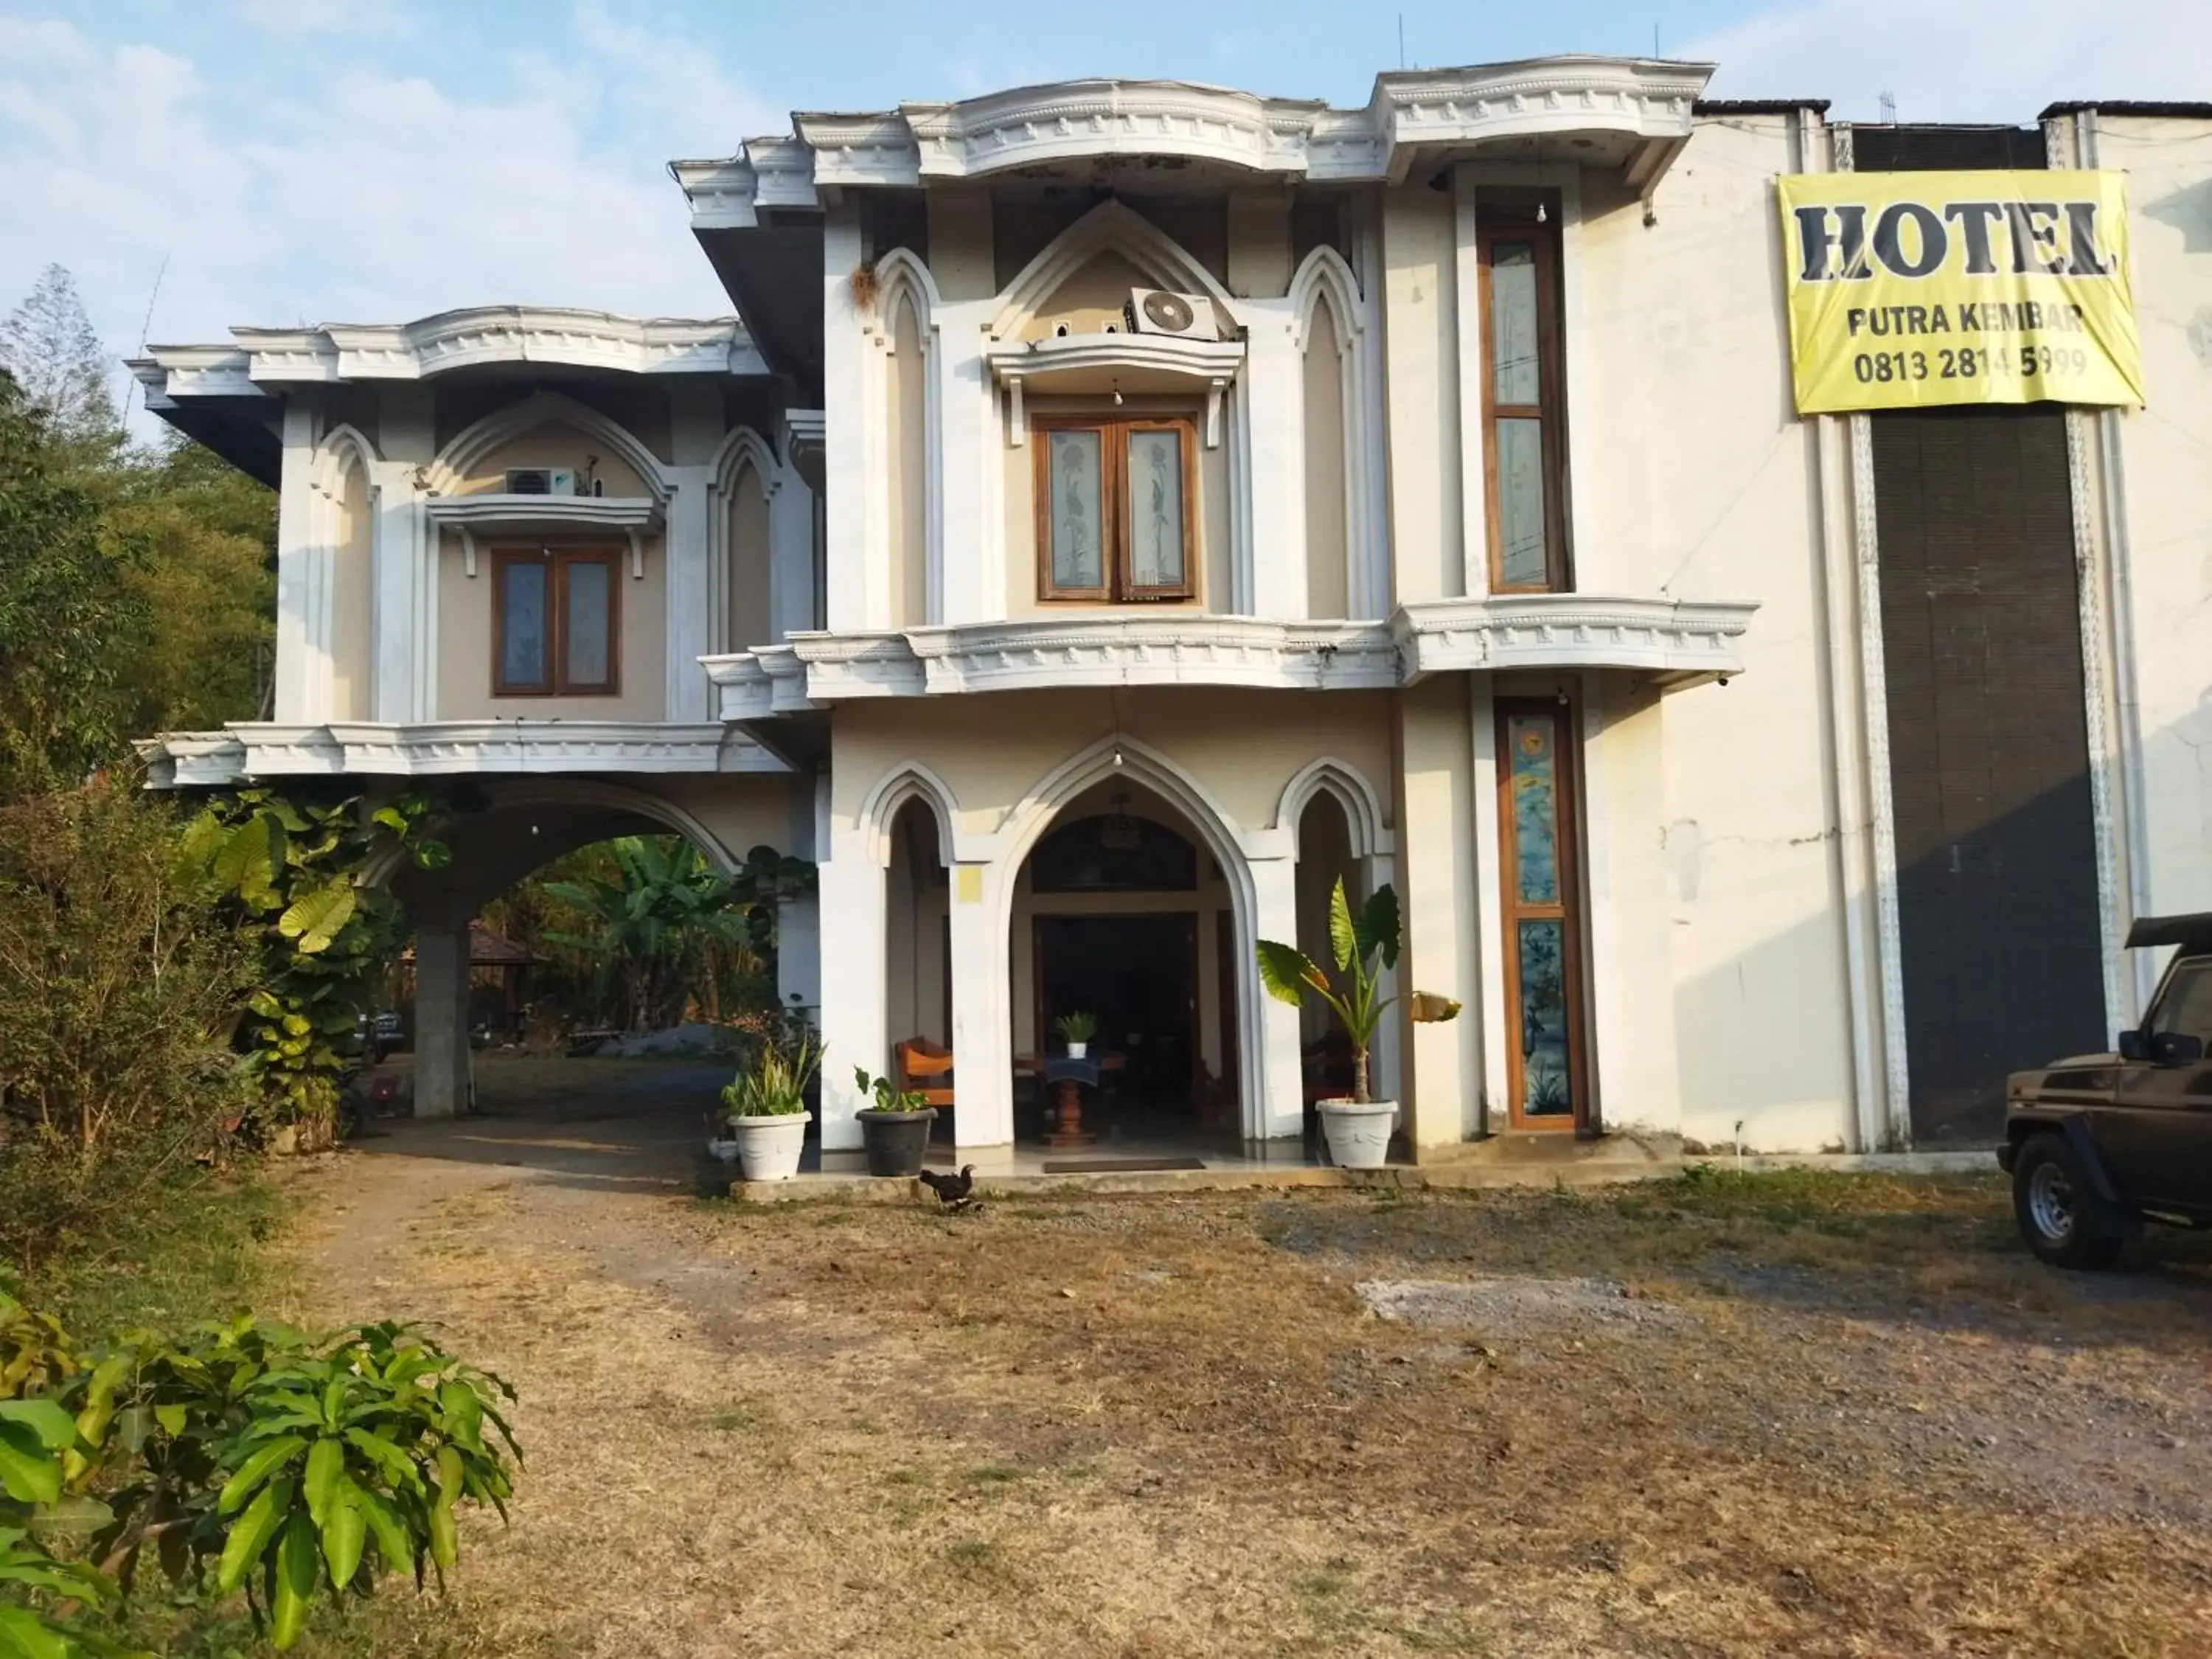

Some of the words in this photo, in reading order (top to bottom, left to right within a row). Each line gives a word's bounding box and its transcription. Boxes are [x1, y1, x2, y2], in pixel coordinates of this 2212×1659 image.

[1794, 202, 2117, 281] HOTEL
[1847, 304, 1951, 337] PUTRA
[1960, 301, 2084, 334] KEMBAR
[1854, 350, 1929, 383] 0813
[1938, 347, 2011, 378] 2814
[2020, 347, 2087, 378] 5999
